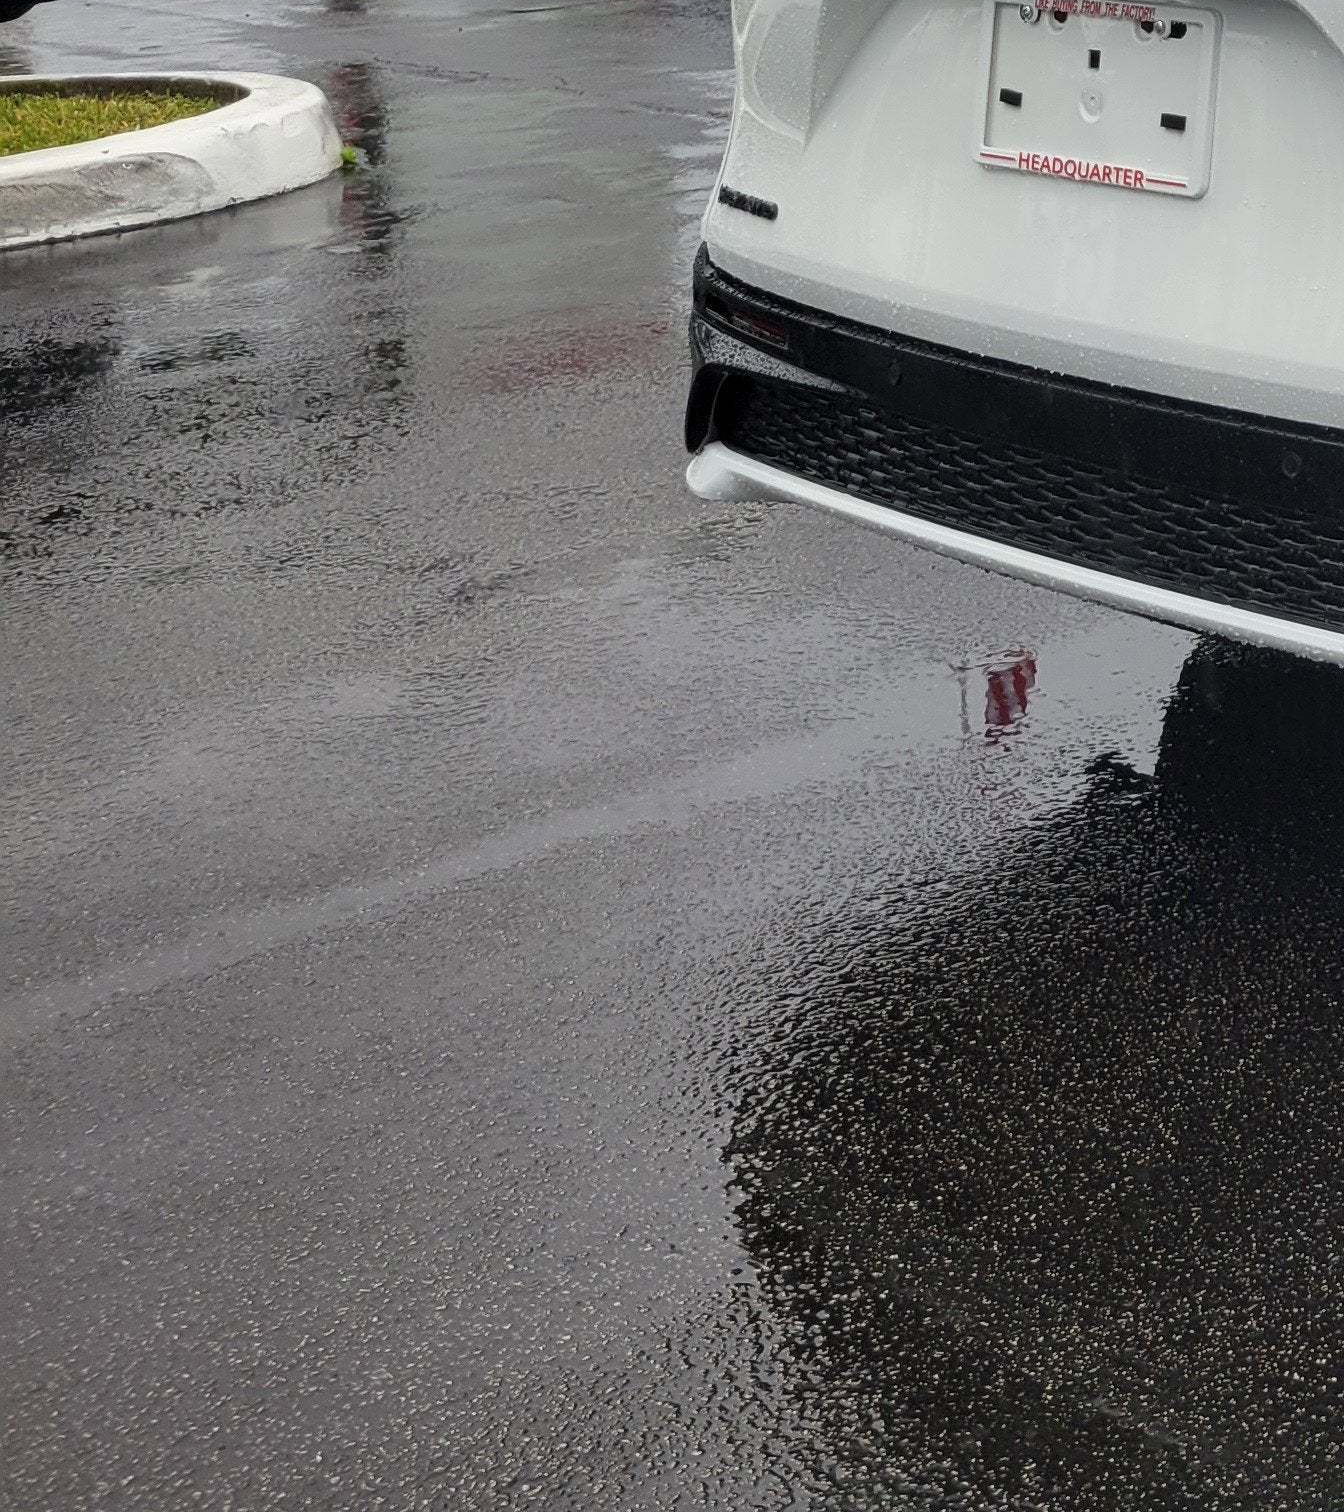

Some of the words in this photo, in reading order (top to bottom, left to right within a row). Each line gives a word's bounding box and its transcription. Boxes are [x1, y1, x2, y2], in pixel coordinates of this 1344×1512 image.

[1080, 0, 1102, 16] FROM
[1104, 1, 1120, 17] THE
[1018, 151, 1145, 188] HEADQUARTER
